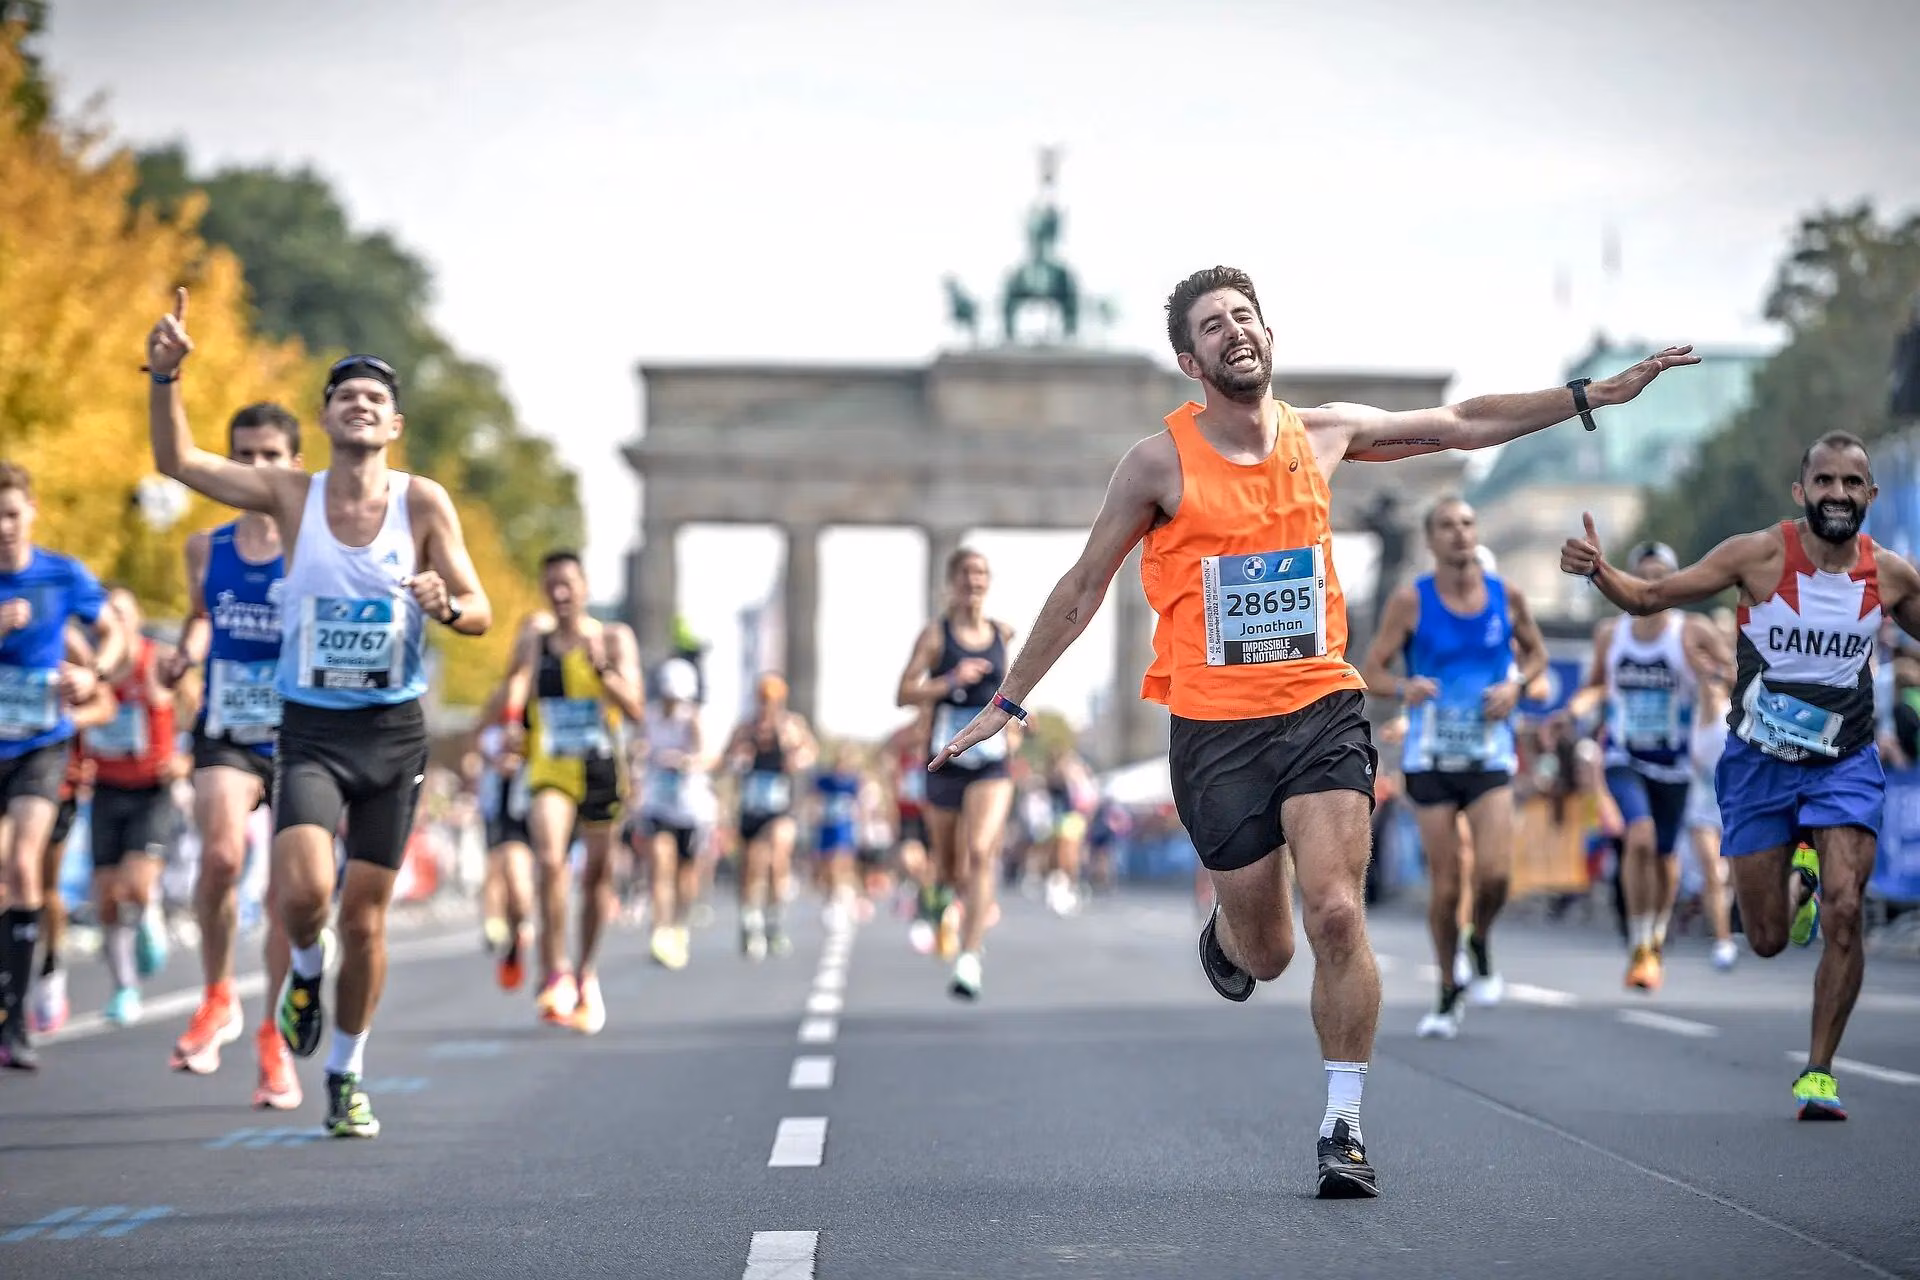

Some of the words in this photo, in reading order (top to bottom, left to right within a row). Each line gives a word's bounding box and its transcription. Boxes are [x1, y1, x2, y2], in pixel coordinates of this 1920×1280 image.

[1318, 579, 1324, 589] B
[1226, 586, 1311, 617] 28695
[1239, 619, 1303, 637] Jonathan
[317, 628, 387, 651] 20767
[1242, 637, 1291, 653] IMPOSSIBLE
[1242, 652, 1252, 663] IS
[1252, 649, 1289, 663] NOTHING
